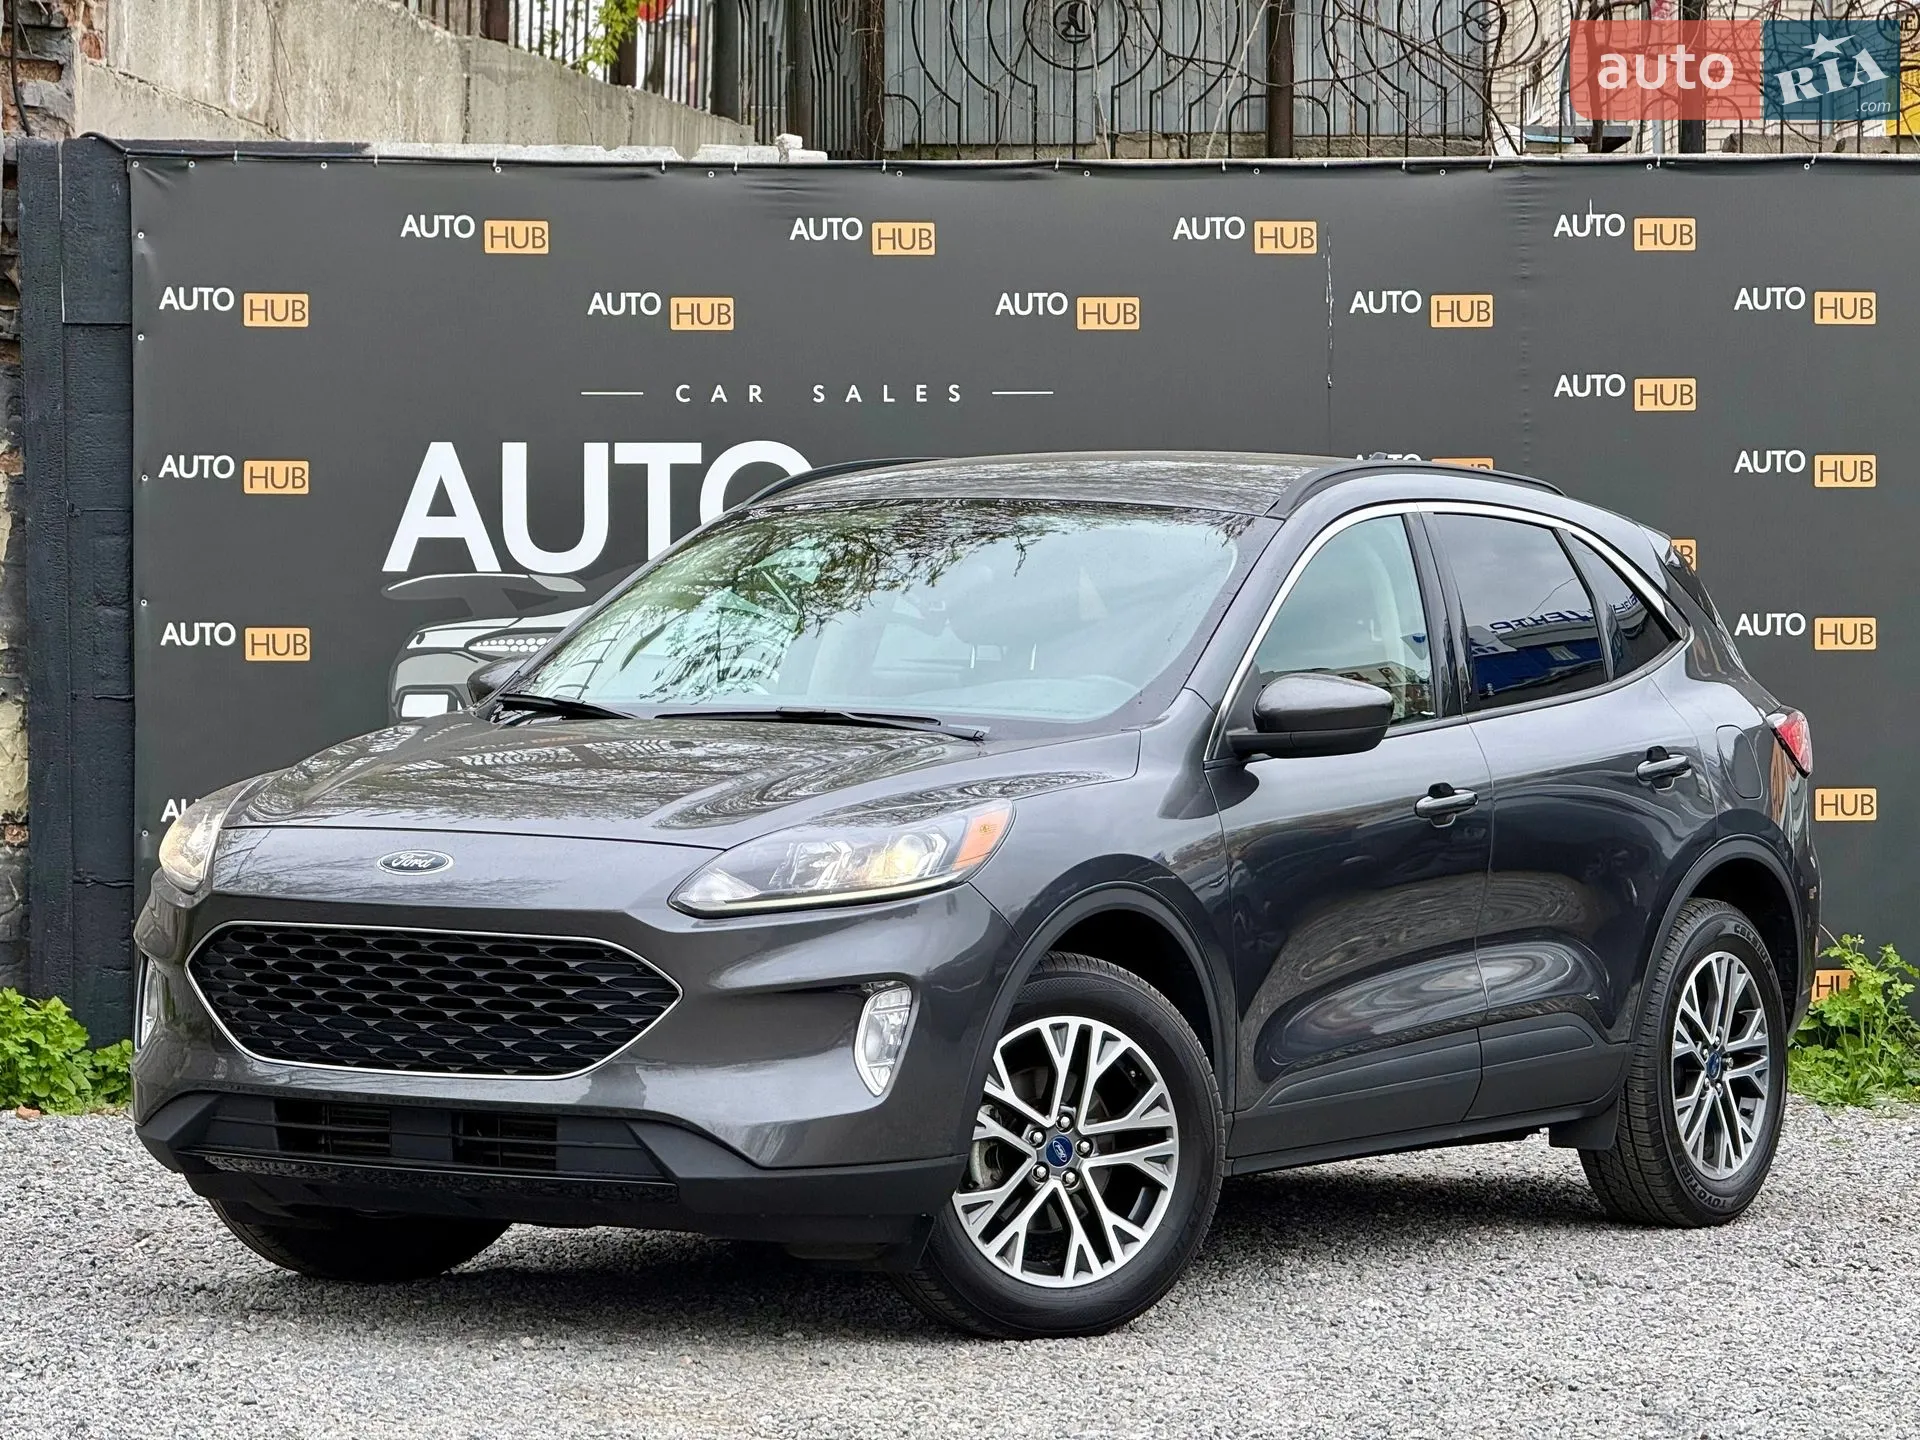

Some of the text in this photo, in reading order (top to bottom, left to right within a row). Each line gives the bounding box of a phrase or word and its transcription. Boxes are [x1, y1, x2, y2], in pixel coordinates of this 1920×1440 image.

[400, 214, 546, 249] AUTO HUB
[789, 216, 933, 251] AUTO HUB
[1172, 215, 1315, 249] AUTO HUB
[1553, 212, 1693, 246] AUTO HUB
[158, 286, 306, 322] AUTO HUB
[586, 291, 731, 326] AUTO HUB
[994, 291, 1137, 325] AUTO HUB
[1349, 289, 1491, 323] AUTO HUB
[1733, 286, 1873, 320] AUTO HUB
[675, 383, 962, 403] CAR SALES
[1553, 373, 1694, 407] AUTO HUB
[158, 454, 306, 489] AUTO HUB
[1733, 449, 1874, 483] AUTO HUB
[160, 622, 308, 657] AUTO HUB
[1733, 612, 1874, 646] AUTO HUB
[1820, 793, 1873, 817] HUB
[391, 852, 436, 869] Ford
